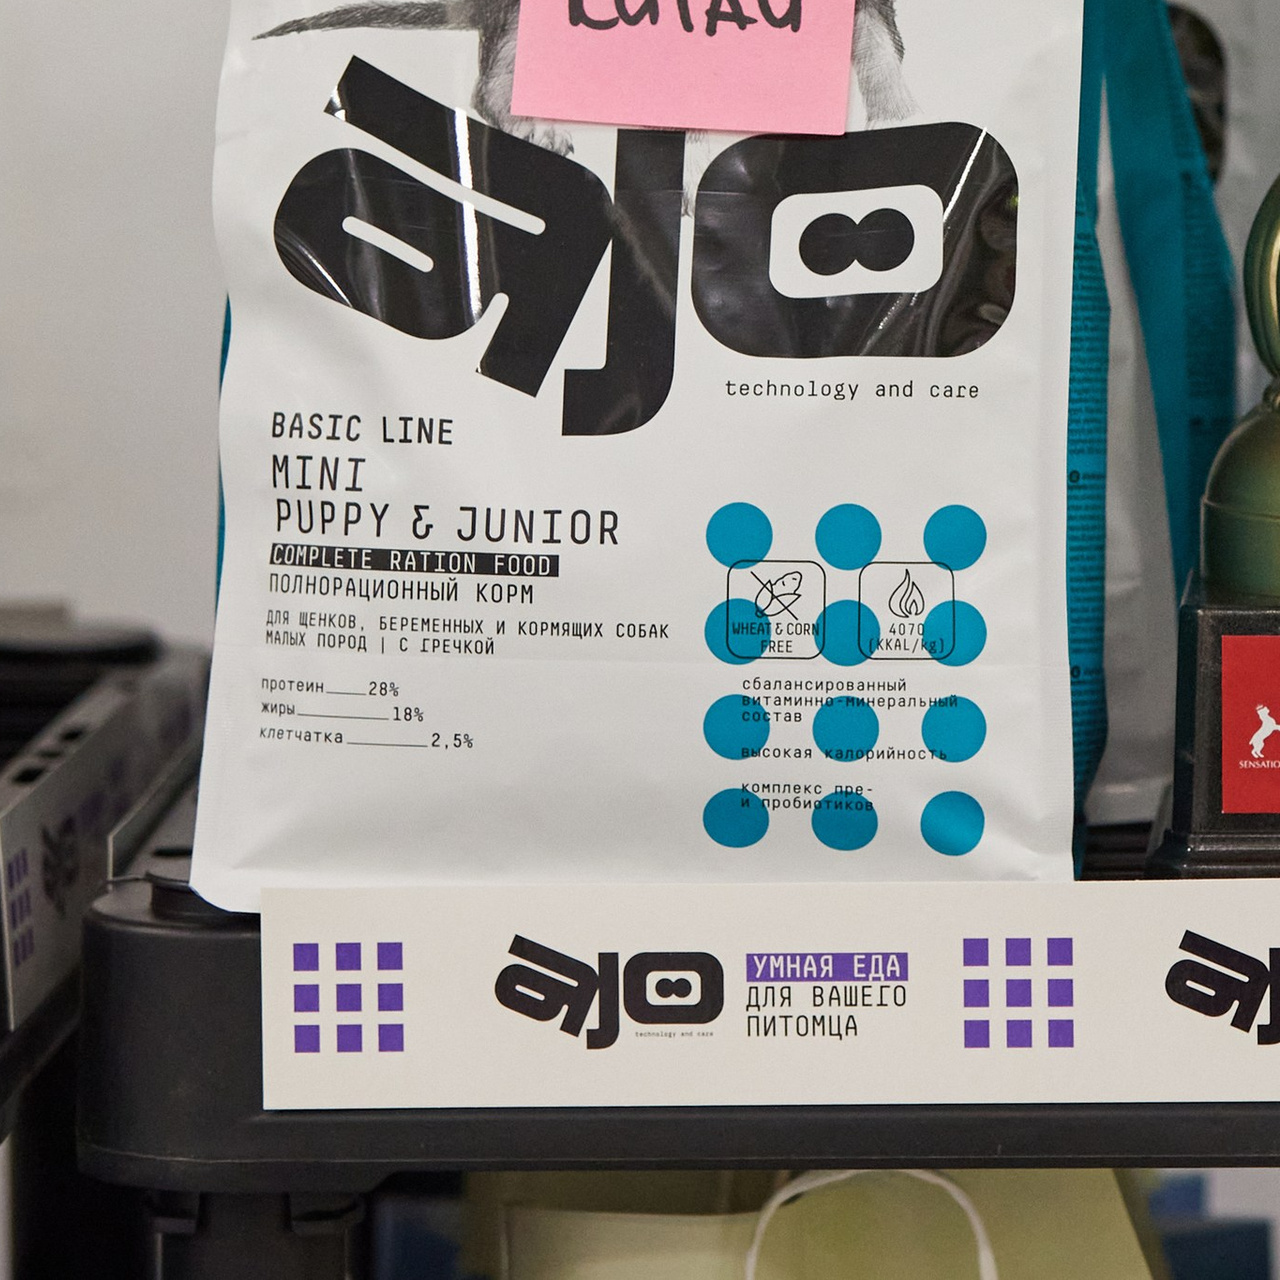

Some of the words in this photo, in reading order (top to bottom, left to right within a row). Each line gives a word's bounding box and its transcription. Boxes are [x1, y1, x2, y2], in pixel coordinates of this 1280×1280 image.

[725, 379, 859, 401] technology
[875, 379, 914, 399] and
[929, 381, 979, 400] care
[271, 412, 362, 442] BASIC
[382, 417, 454, 445] LINE
[271, 455, 366, 492] MINI
[275, 498, 390, 538] PUPPY
[411, 505, 434, 540] &
[456, 506, 620, 545] JUNIOR
[272, 544, 373, 570] COMPLETE
[390, 550, 477, 574] RATION
[494, 554, 551, 576] FOOD
[268, 572, 459, 604] ПОЛНОРАЦИОННЫЙ
[476, 583, 534, 604] КОРМ
[266, 609, 290, 627] ДЛЯ
[298, 612, 364, 631] ЩЕНКОВ,
[379, 616, 484, 635] БЕРЕМЕННЫХ
[496, 620, 505, 635] И
[518, 621, 604, 639] КОРМЯЩИХ
[616, 623, 669, 639] СОБАК
[732, 622, 772, 636] WHEAT
[786, 623, 820, 637] CORN
[888, 622, 925, 636] 4070
[265, 630, 305, 648] МАЛЫХ
[316, 632, 368, 653] ПОРОД
[399, 636, 409, 652] С
[420, 635, 495, 655] ГРЕЧКОЙ
[760, 639, 793, 654] FREE
[261, 676, 324, 696] протеин
[368, 681, 400, 698] 28%
[742, 677, 907, 694] сбалансированный
[741, 692, 958, 709] витаминно-минеральный
[260, 701, 296, 718] жиры
[393, 706, 424, 723] 18%
[742, 710, 802, 723] состав
[259, 725, 343, 745] клетчатка
[431, 732, 473, 751] 2,5%
[741, 745, 813, 759] высокая
[825, 746, 947, 762] калорийность
[741, 783, 822, 795] комплекс
[741, 797, 750, 808] и
[761, 794, 874, 812] пробиотиков
[754, 954, 834, 980] УМНАЯ
[853, 954, 903, 983] ЕДА
[745, 985, 793, 1012] ДЛЯ
[811, 984, 908, 1008] ВАШЕГО
[746, 1014, 859, 1041] ПИТОМЦА
